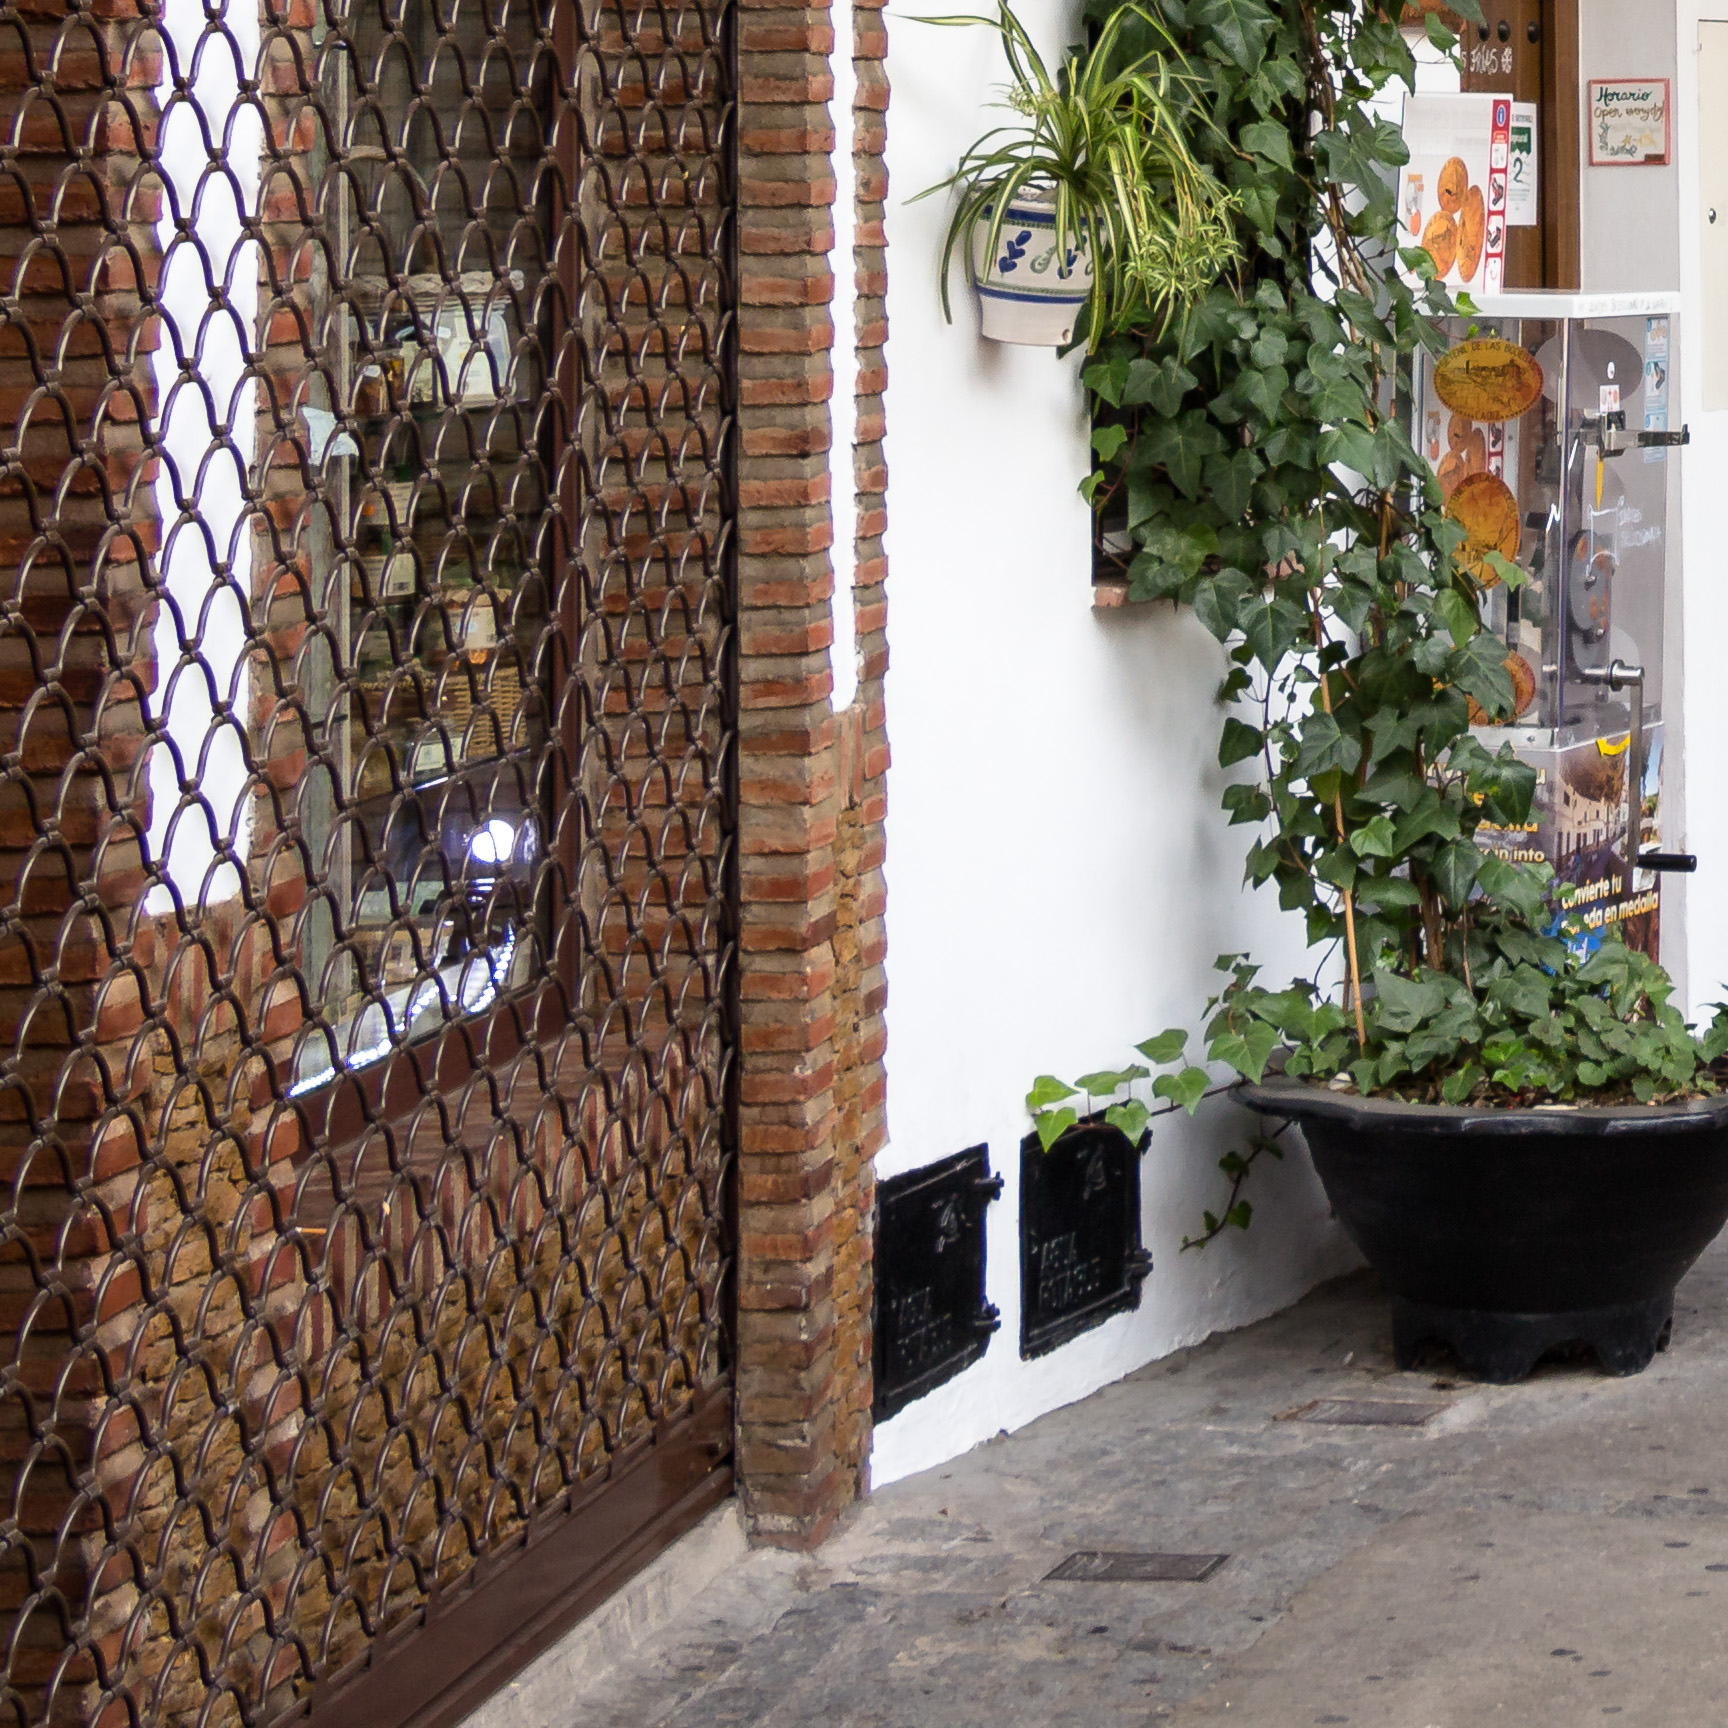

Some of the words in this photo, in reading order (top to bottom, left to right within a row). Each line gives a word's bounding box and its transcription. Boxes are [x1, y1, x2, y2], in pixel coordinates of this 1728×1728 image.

[1596, 86, 1653, 107] Horario
[1514, 845, 1545, 862] into
[1604, 904, 1618, 925] en
[1618, 890, 1659, 921] medalla
